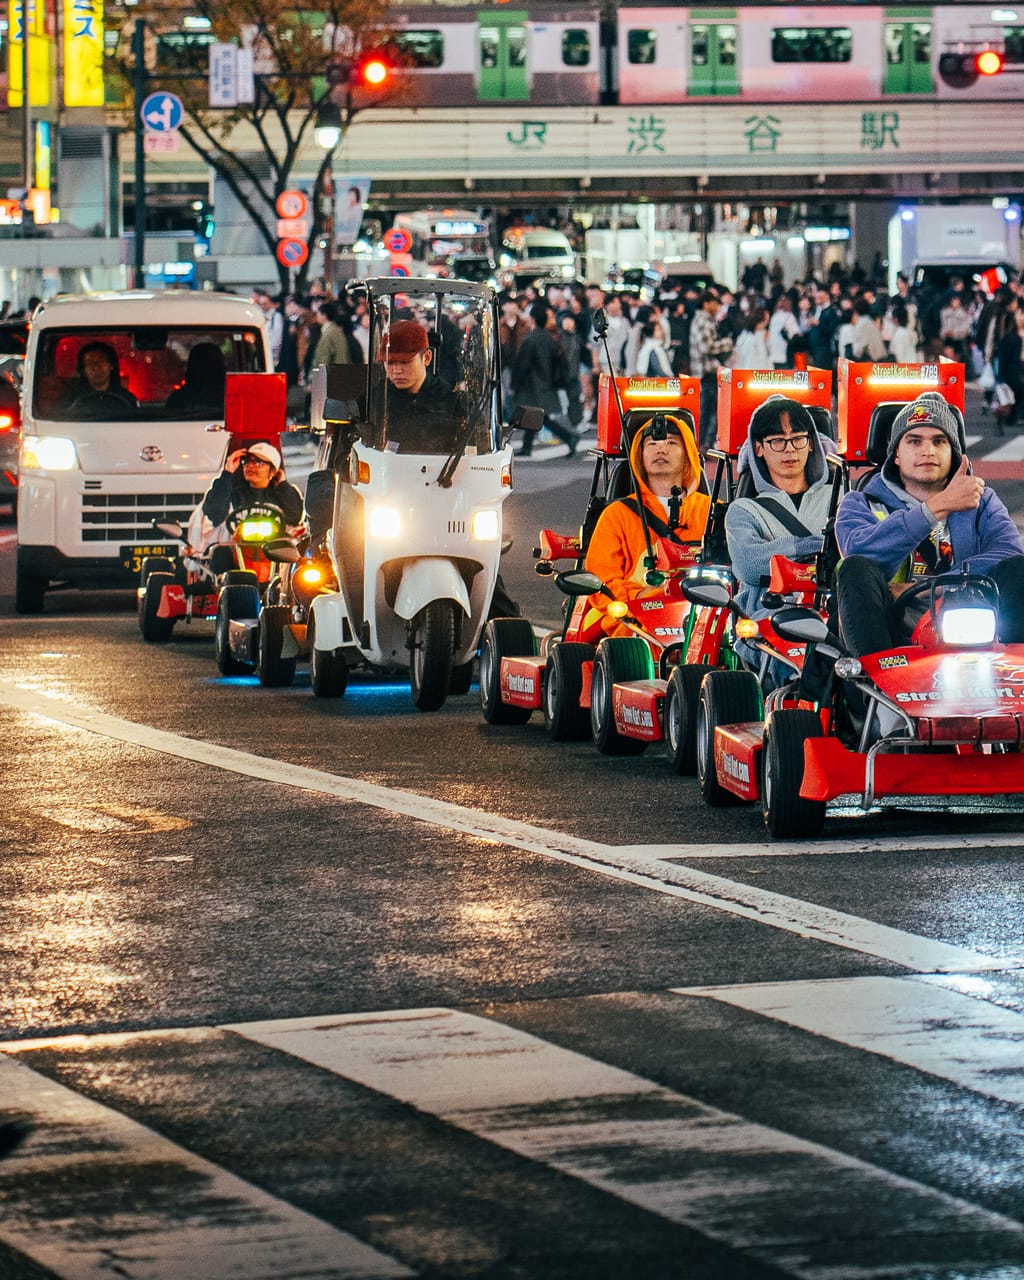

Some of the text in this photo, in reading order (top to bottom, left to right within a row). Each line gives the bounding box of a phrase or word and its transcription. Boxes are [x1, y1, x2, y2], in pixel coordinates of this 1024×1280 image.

[507, 111, 900, 154] JR 渋谷駅
